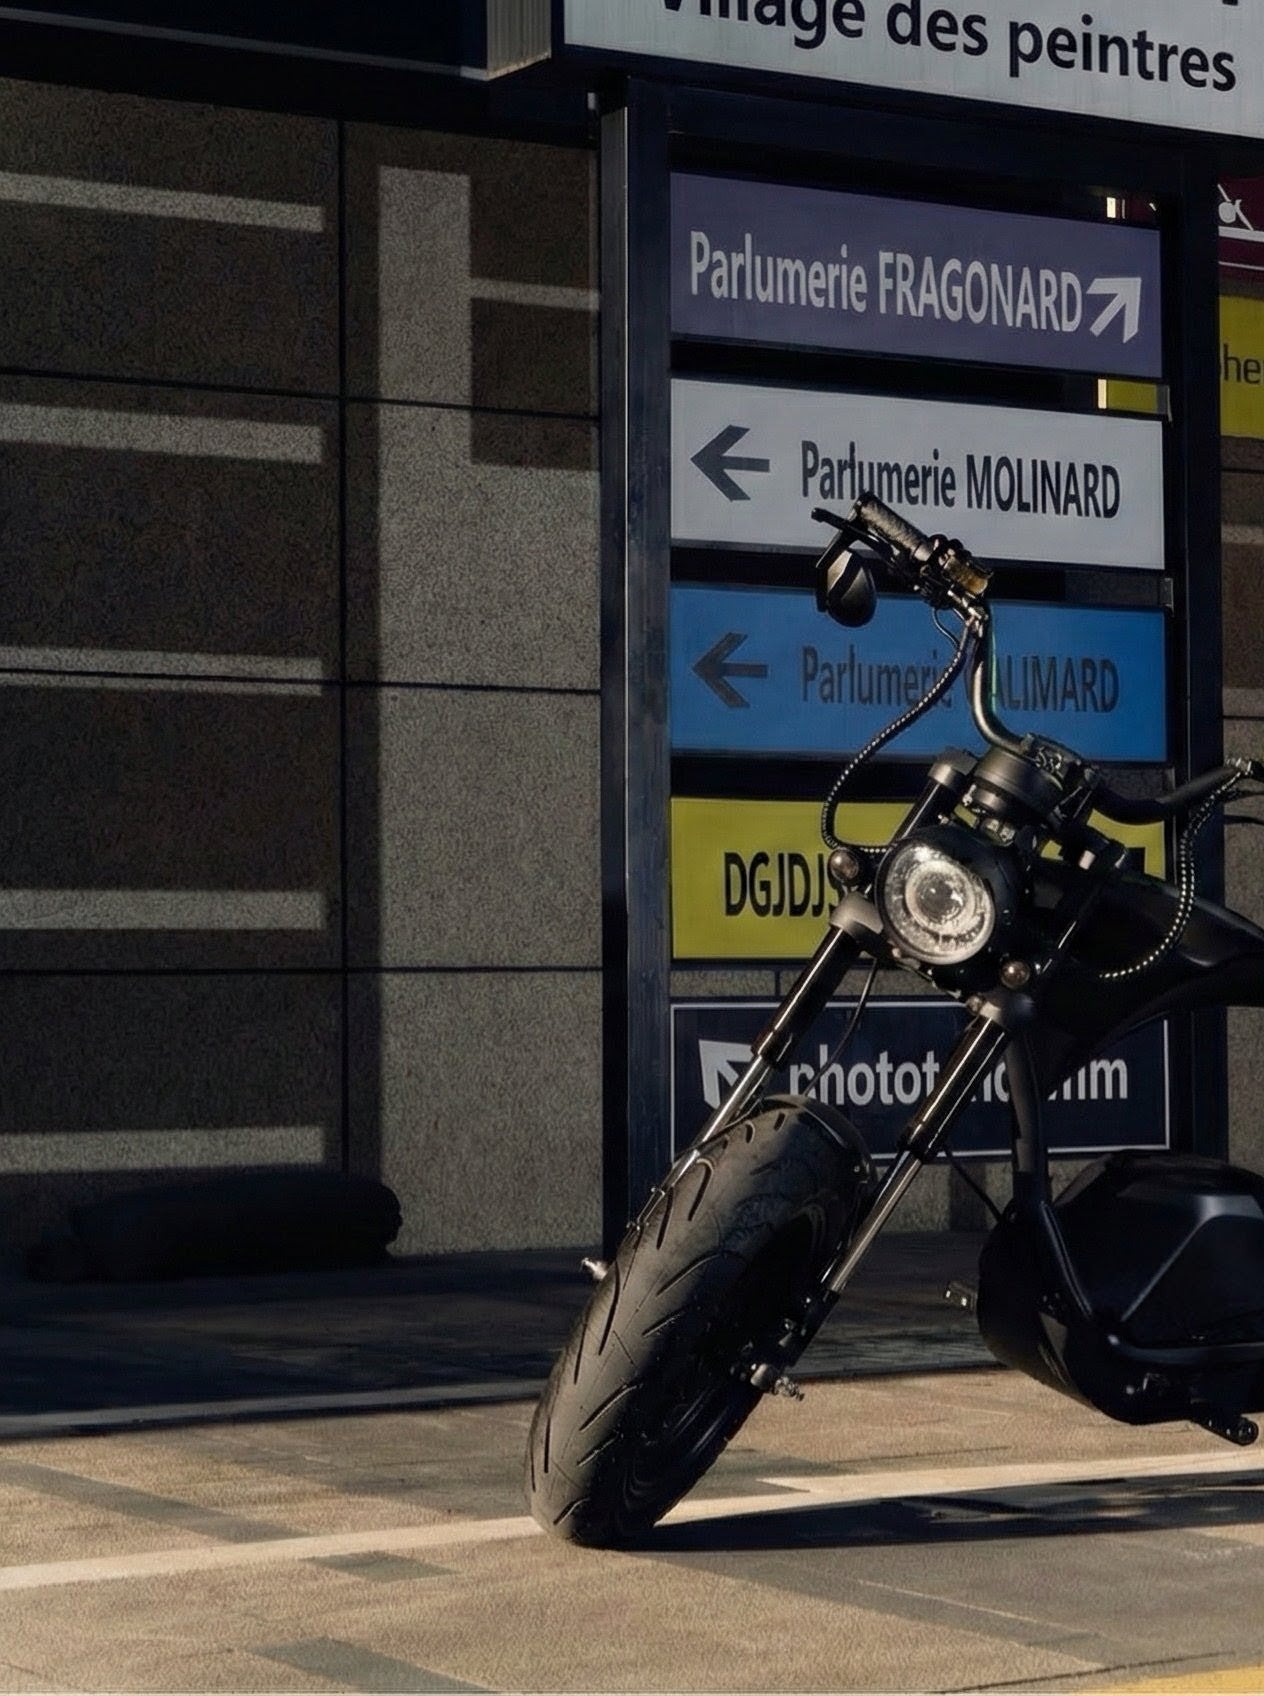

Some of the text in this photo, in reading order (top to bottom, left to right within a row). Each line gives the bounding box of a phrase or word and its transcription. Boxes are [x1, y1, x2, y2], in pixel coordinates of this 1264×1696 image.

[886, 0, 989, 56] des
[1009, 14, 1236, 91] peintres
[690, 230, 1083, 332] Parlumerie FRAGONARD
[966, 454, 1121, 519] MOLINARD
